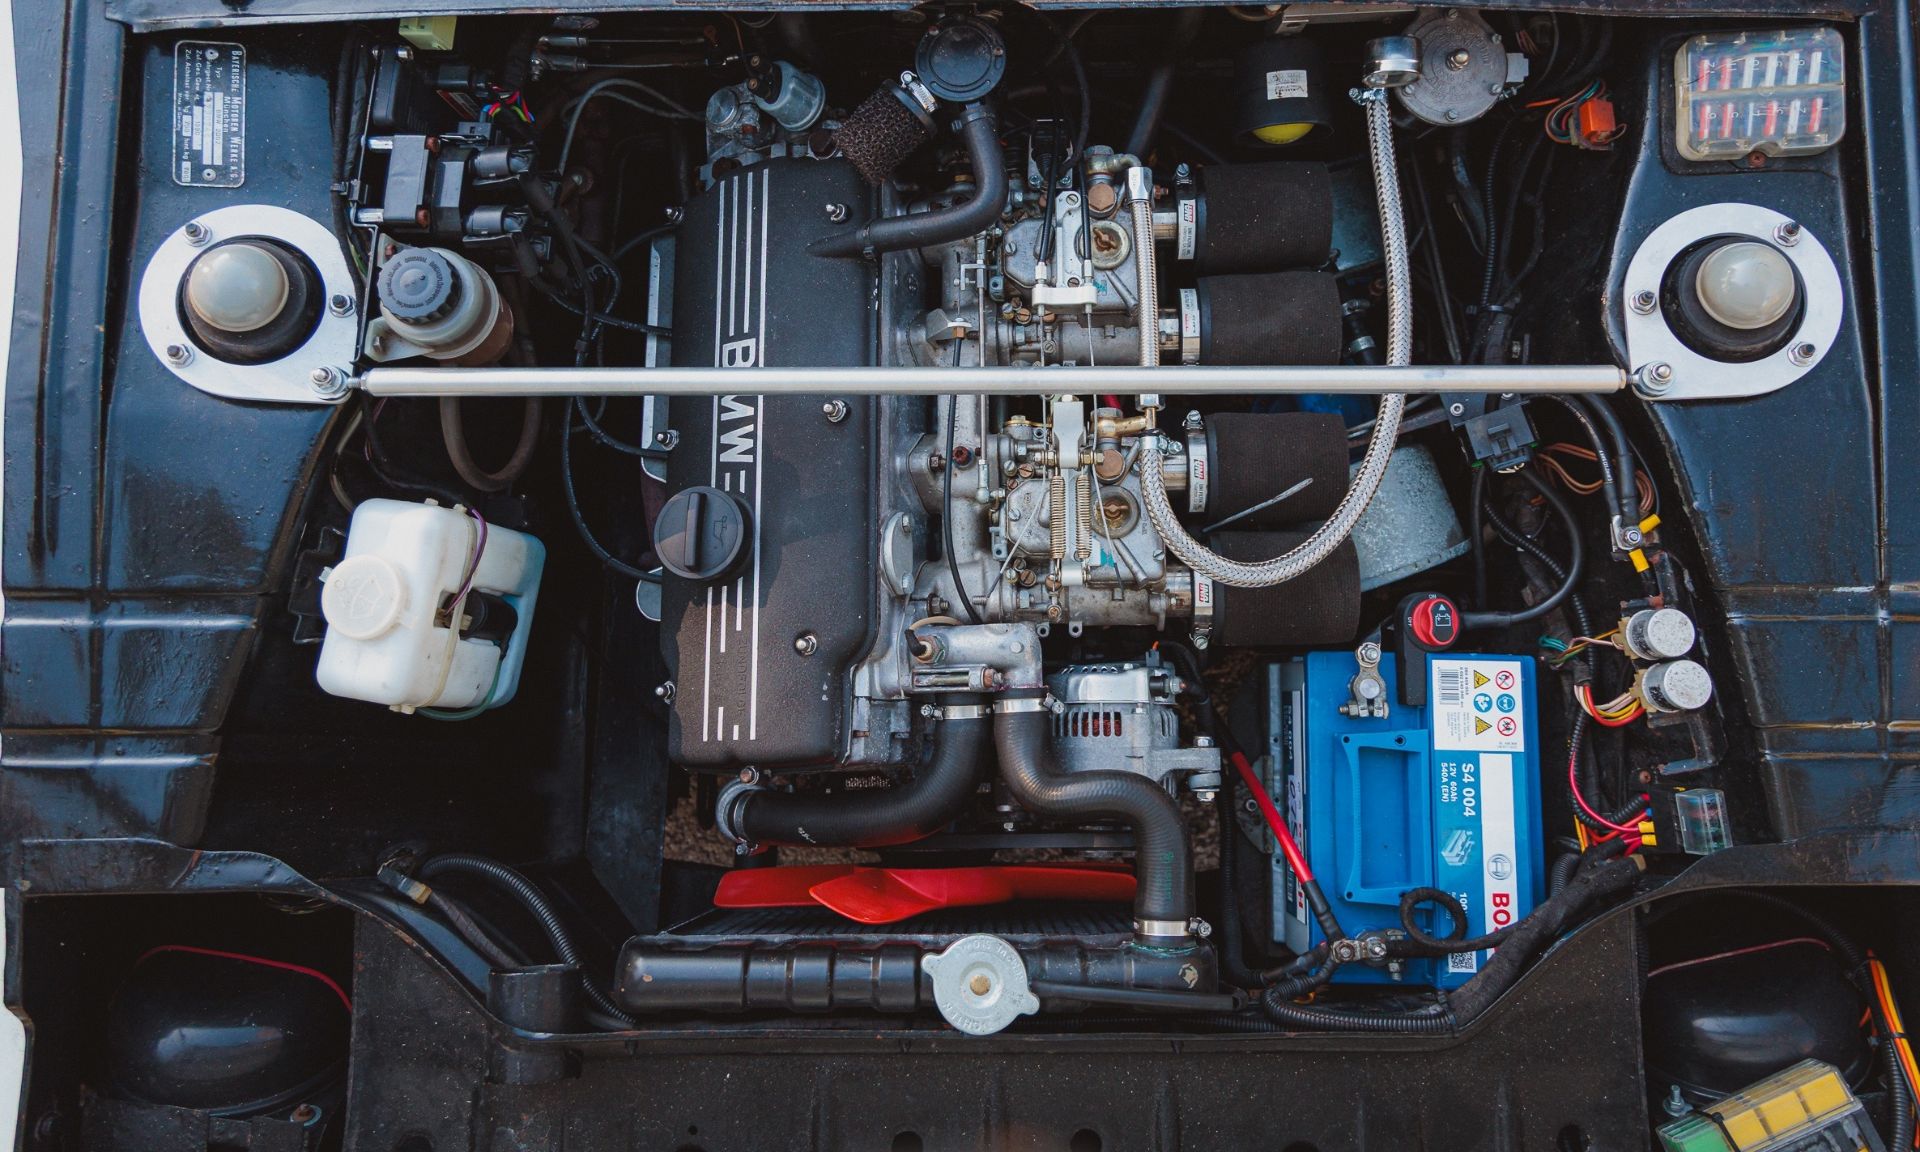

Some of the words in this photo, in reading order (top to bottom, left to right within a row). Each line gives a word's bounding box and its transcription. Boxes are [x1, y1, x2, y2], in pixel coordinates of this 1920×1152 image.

[231, 50, 243, 93] BAYERISCHE
[230, 96, 242, 132] MOTOREN
[230, 136, 242, 163] WERKE
[720, 338, 756, 463] BMW
[1440, 762, 1448, 783] 540A
[1449, 762, 1457, 777] 12V
[1461, 763, 1475, 783] S4
[1440, 785, 1449, 802] (EN)
[1449, 782, 1457, 802] 60Ah
[1461, 787, 1476, 817] 004
